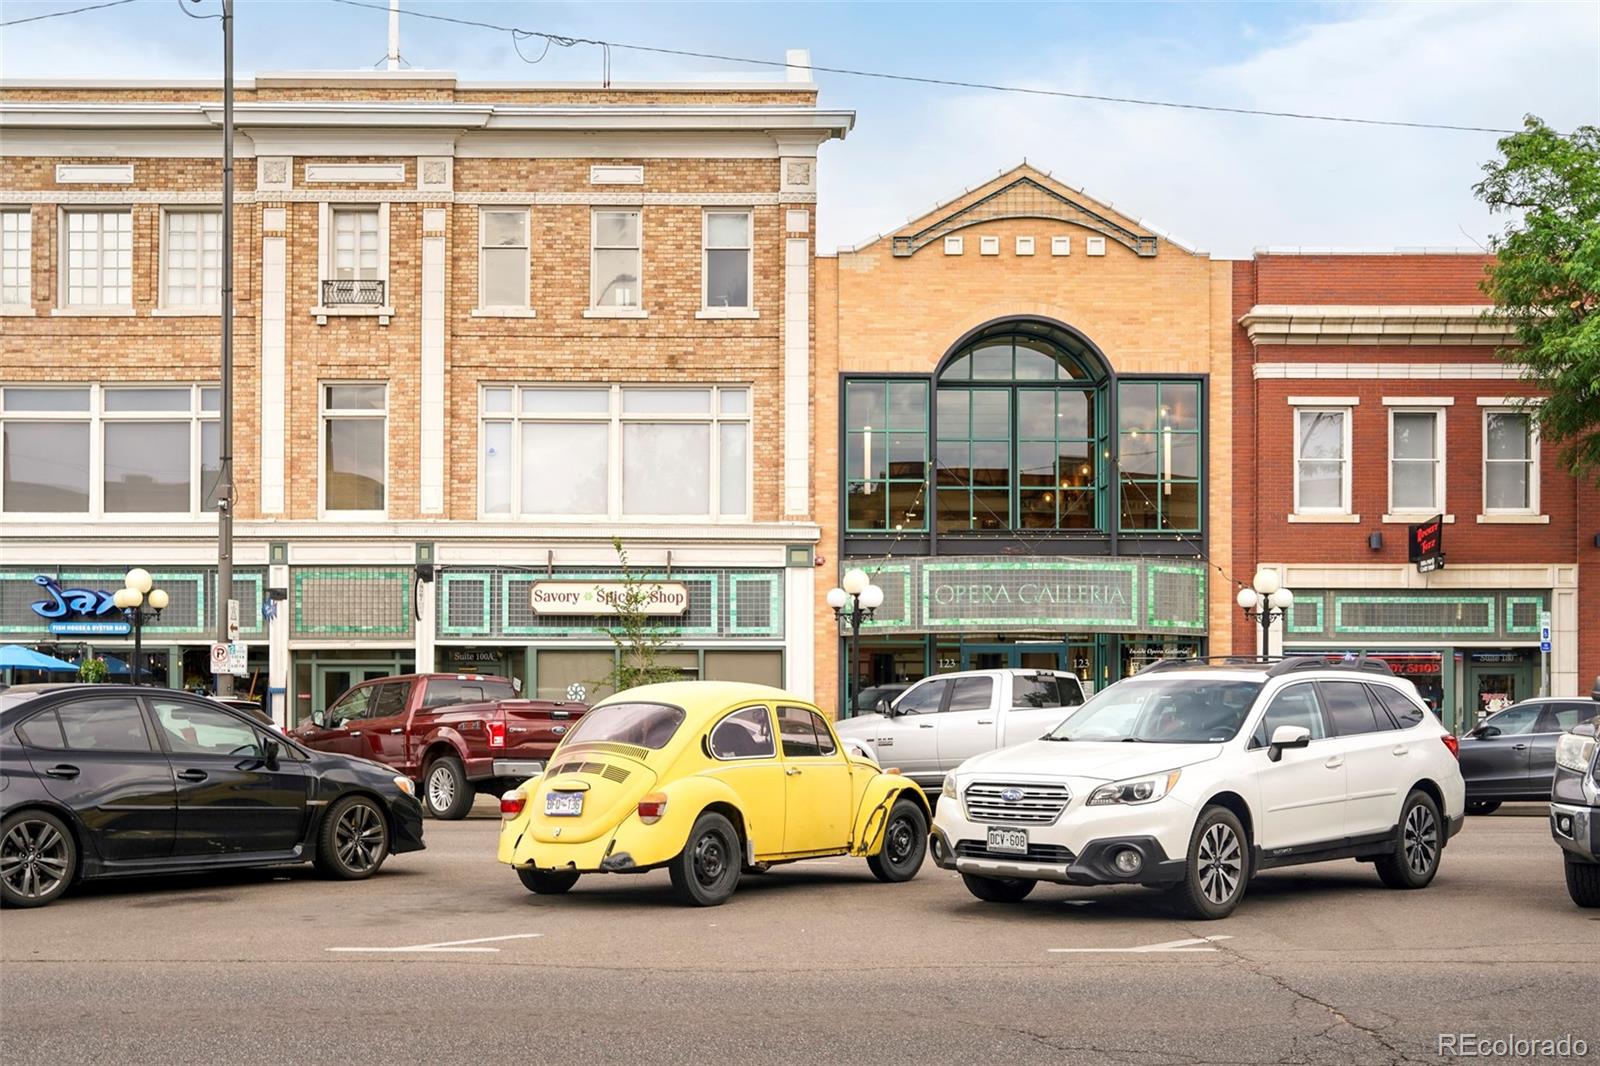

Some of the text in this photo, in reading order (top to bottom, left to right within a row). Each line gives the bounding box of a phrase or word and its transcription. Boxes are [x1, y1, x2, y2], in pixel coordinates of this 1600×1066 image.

[534, 589, 580, 605] Savory
[650, 590, 684, 606] Shop
[935, 583, 1126, 604] OPERA GALLERIA
[454, 652, 474, 660] Suite
[1147, 648, 1164, 656] Opera
[938, 659, 956, 668] 123
[1073, 659, 1090, 668] 123
[1407, 663, 1440, 673] SHOP
